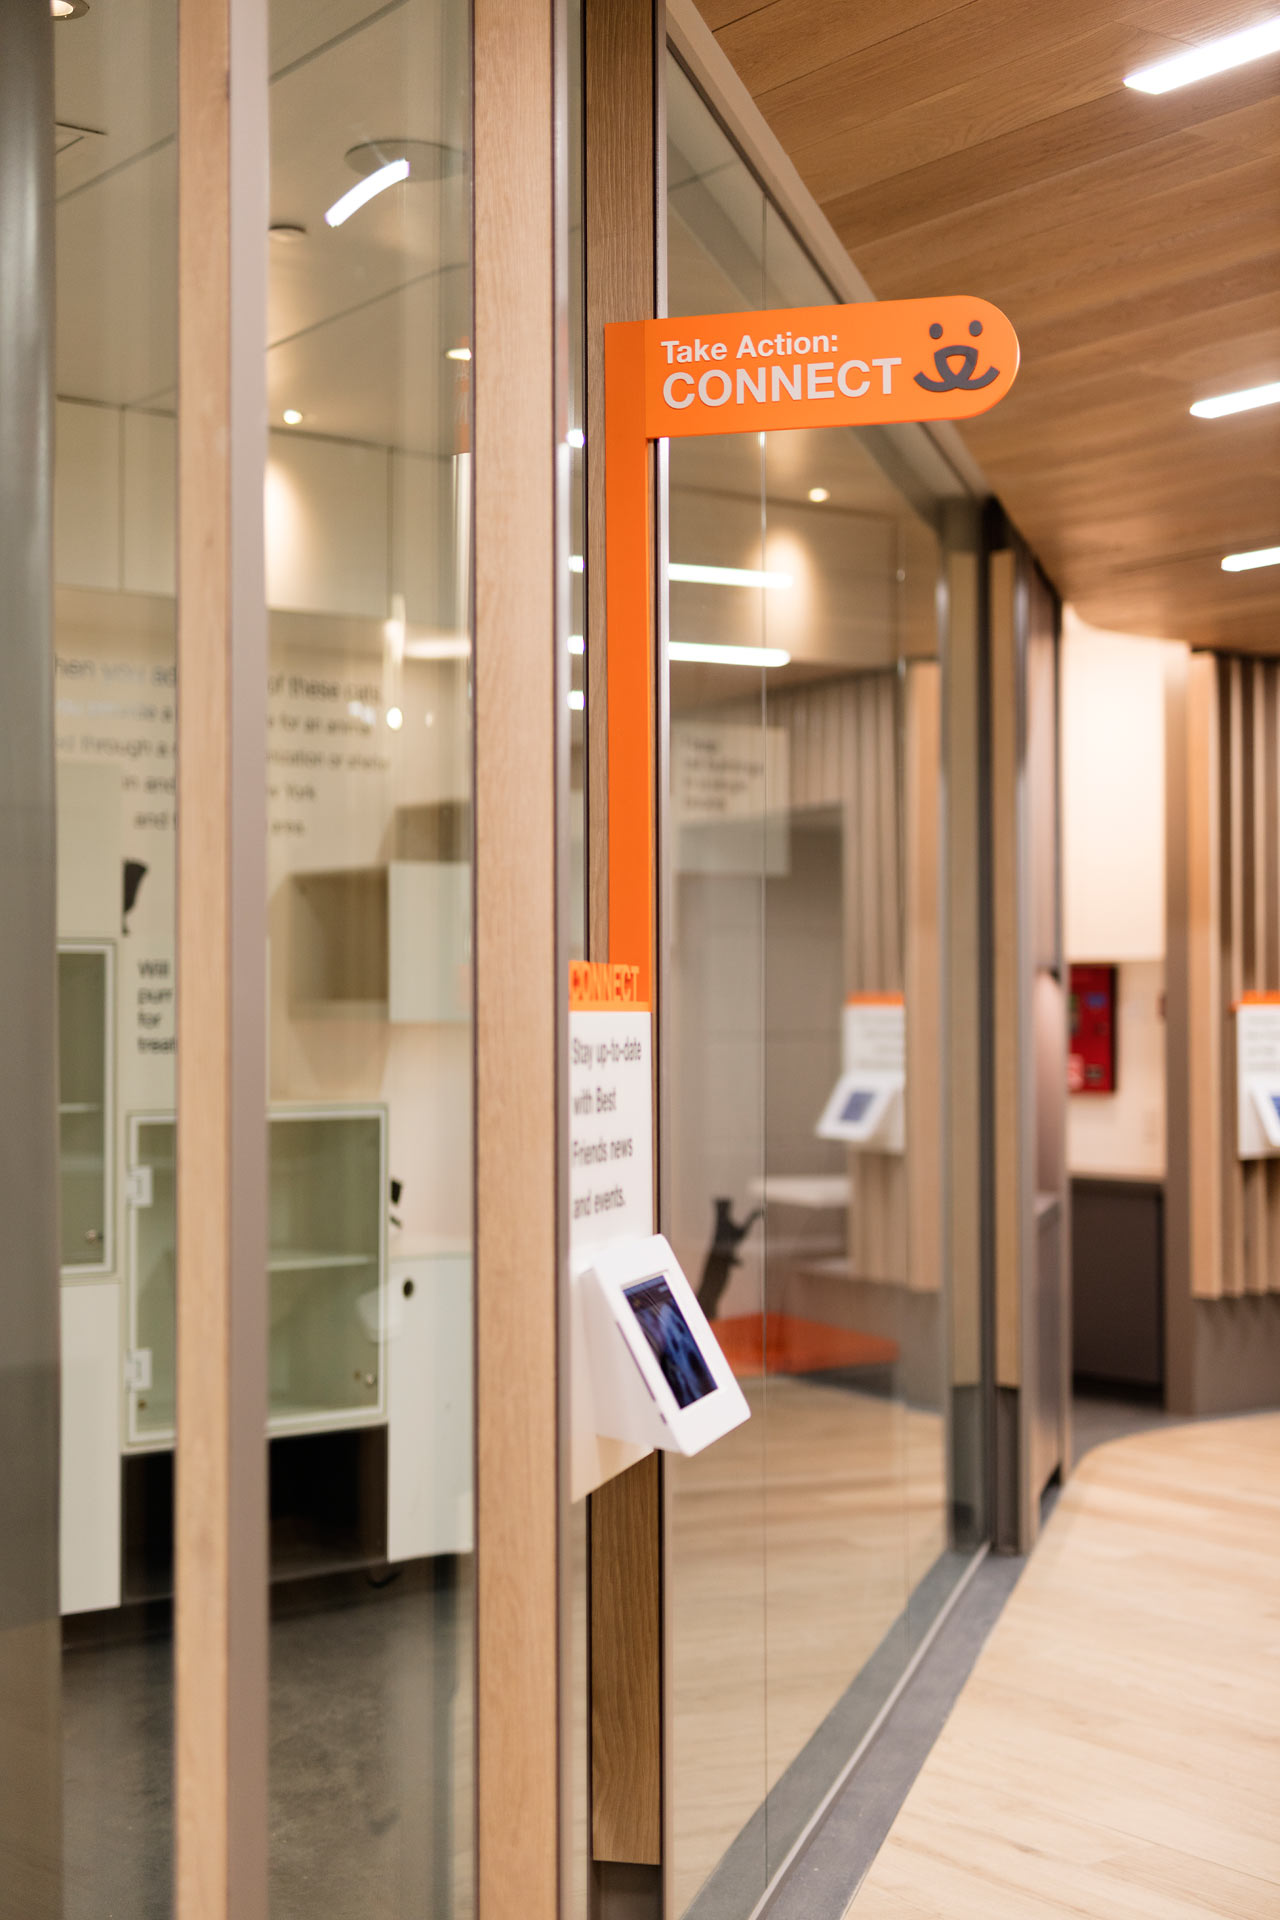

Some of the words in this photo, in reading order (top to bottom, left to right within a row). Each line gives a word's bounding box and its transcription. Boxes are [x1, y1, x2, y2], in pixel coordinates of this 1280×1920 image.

[661, 339, 727, 364] Take
[736, 332, 838, 359] Action:
[663, 357, 902, 410] CONNECT
[569, 962, 639, 1002] CONNECT
[572, 1038, 593, 1071] Stay
[596, 1036, 642, 1068] up-to-date
[573, 1088, 593, 1115] with
[596, 1085, 617, 1113] Best
[573, 1137, 608, 1167] Friends
[610, 1138, 633, 1160] news
[573, 1189, 591, 1218] and
[594, 1184, 626, 1214] events.
